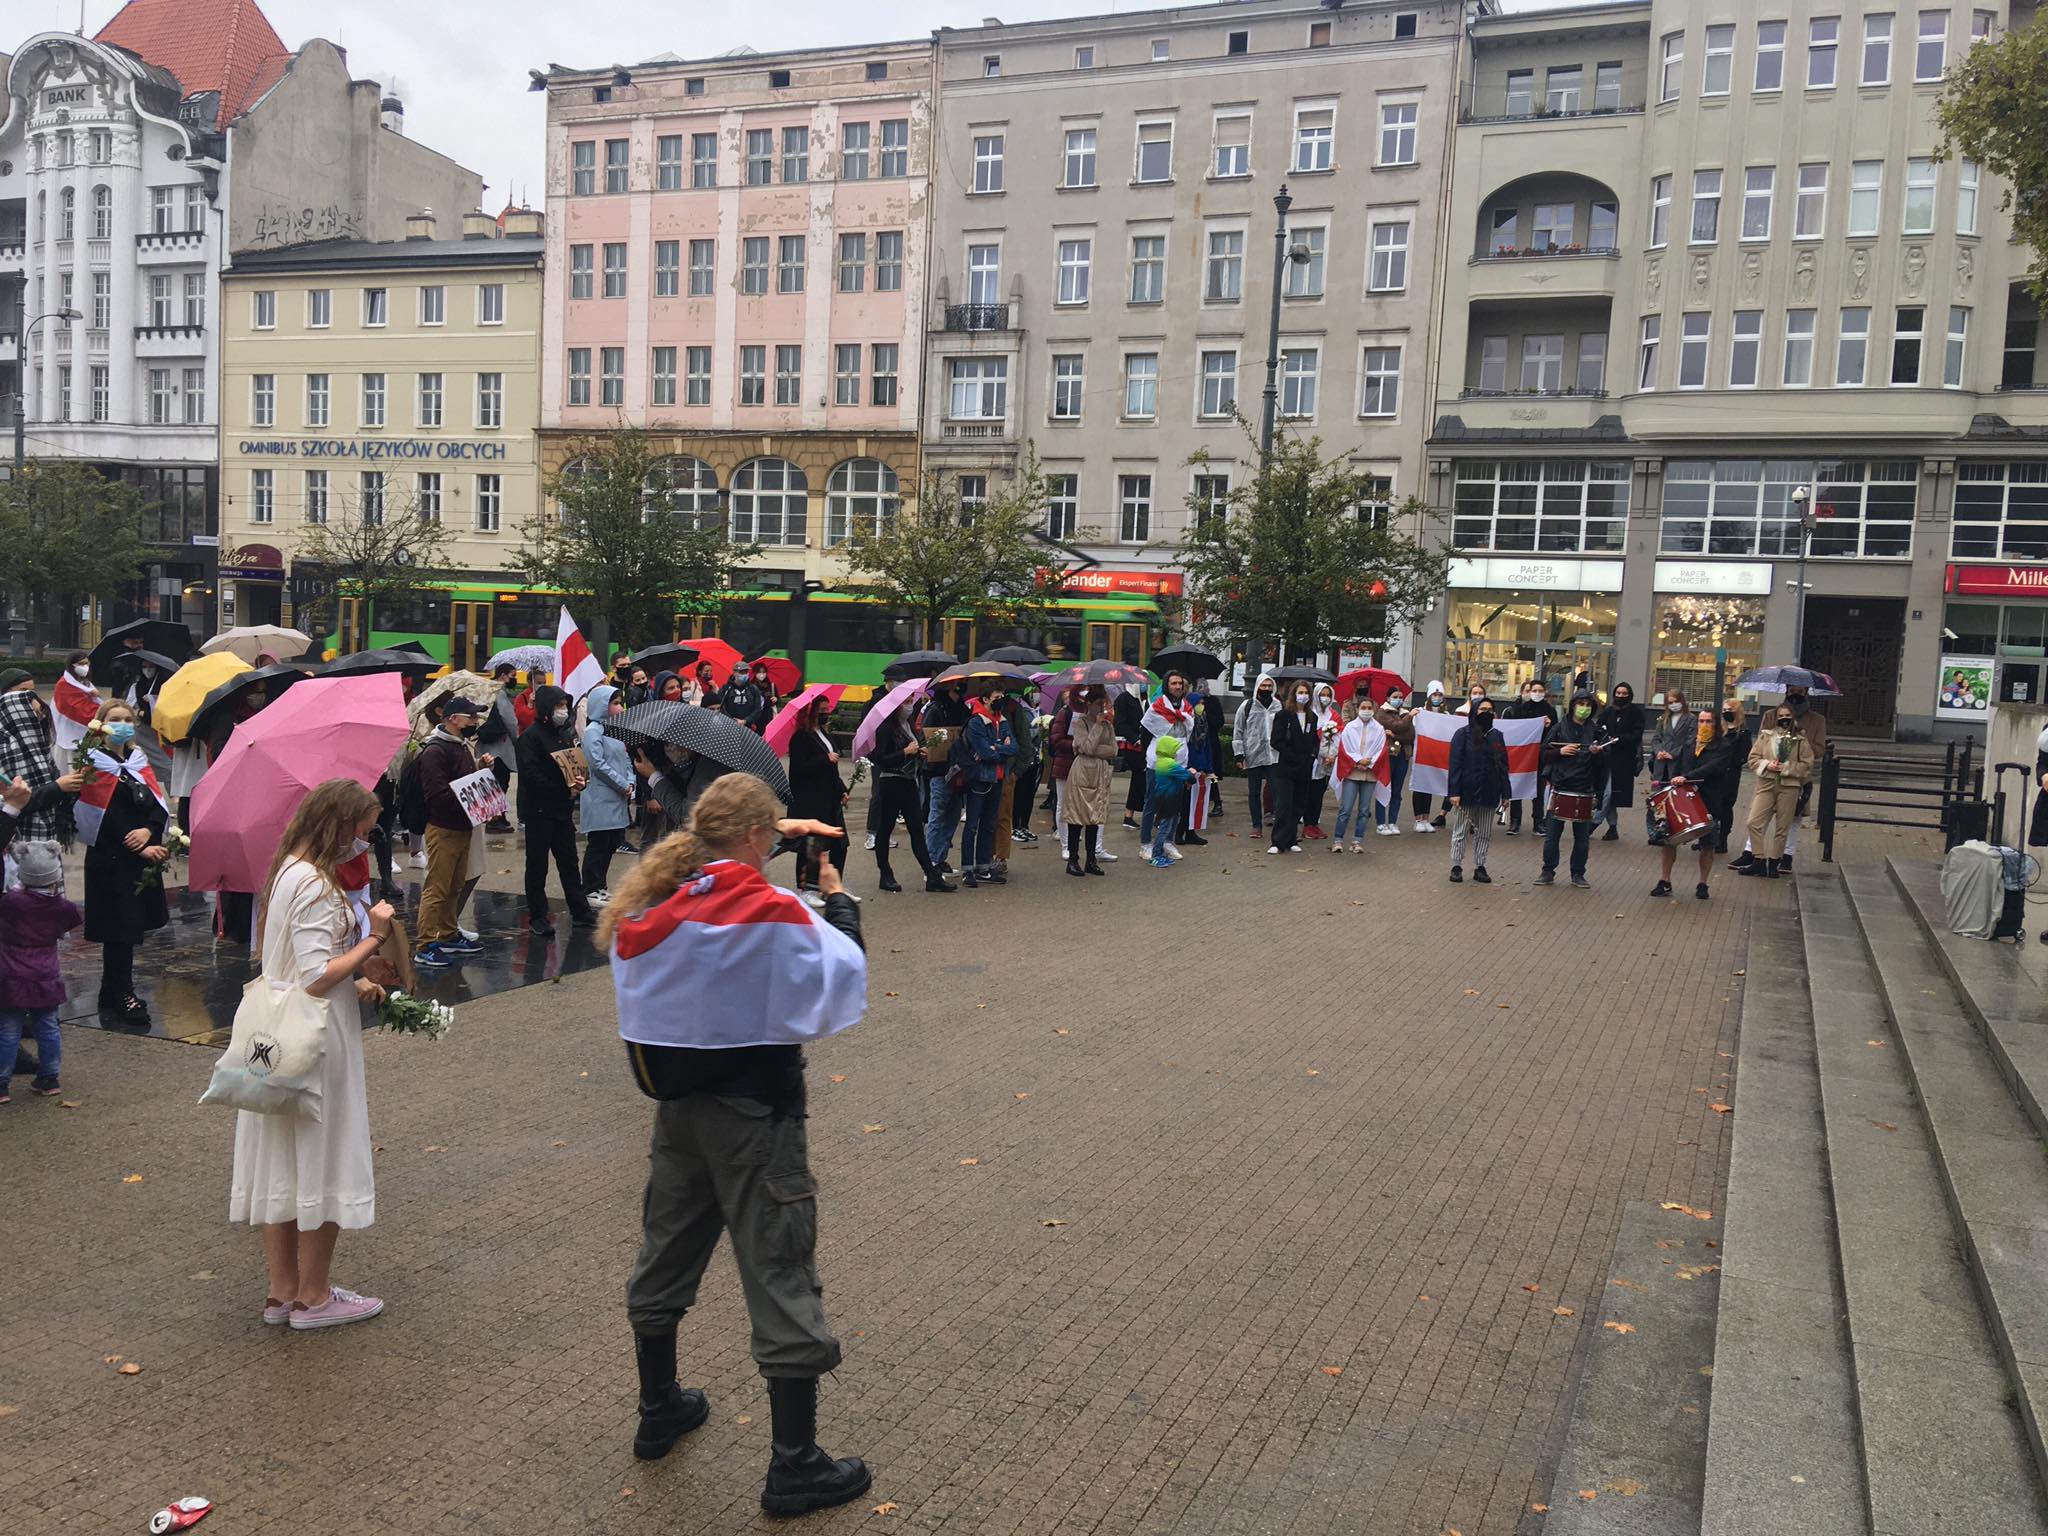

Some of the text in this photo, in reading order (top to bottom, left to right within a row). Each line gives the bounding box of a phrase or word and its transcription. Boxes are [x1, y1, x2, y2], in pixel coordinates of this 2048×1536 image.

[48, 89, 86, 105] BANK
[239, 438, 505, 461] OMNIBUS SZKOŁA JĘZYKÓW OBCYCH
[1519, 565, 1553, 575] PAPER
[1507, 574, 1559, 584] CONCEPT
[1670, 577, 1711, 585] CONCEPT
